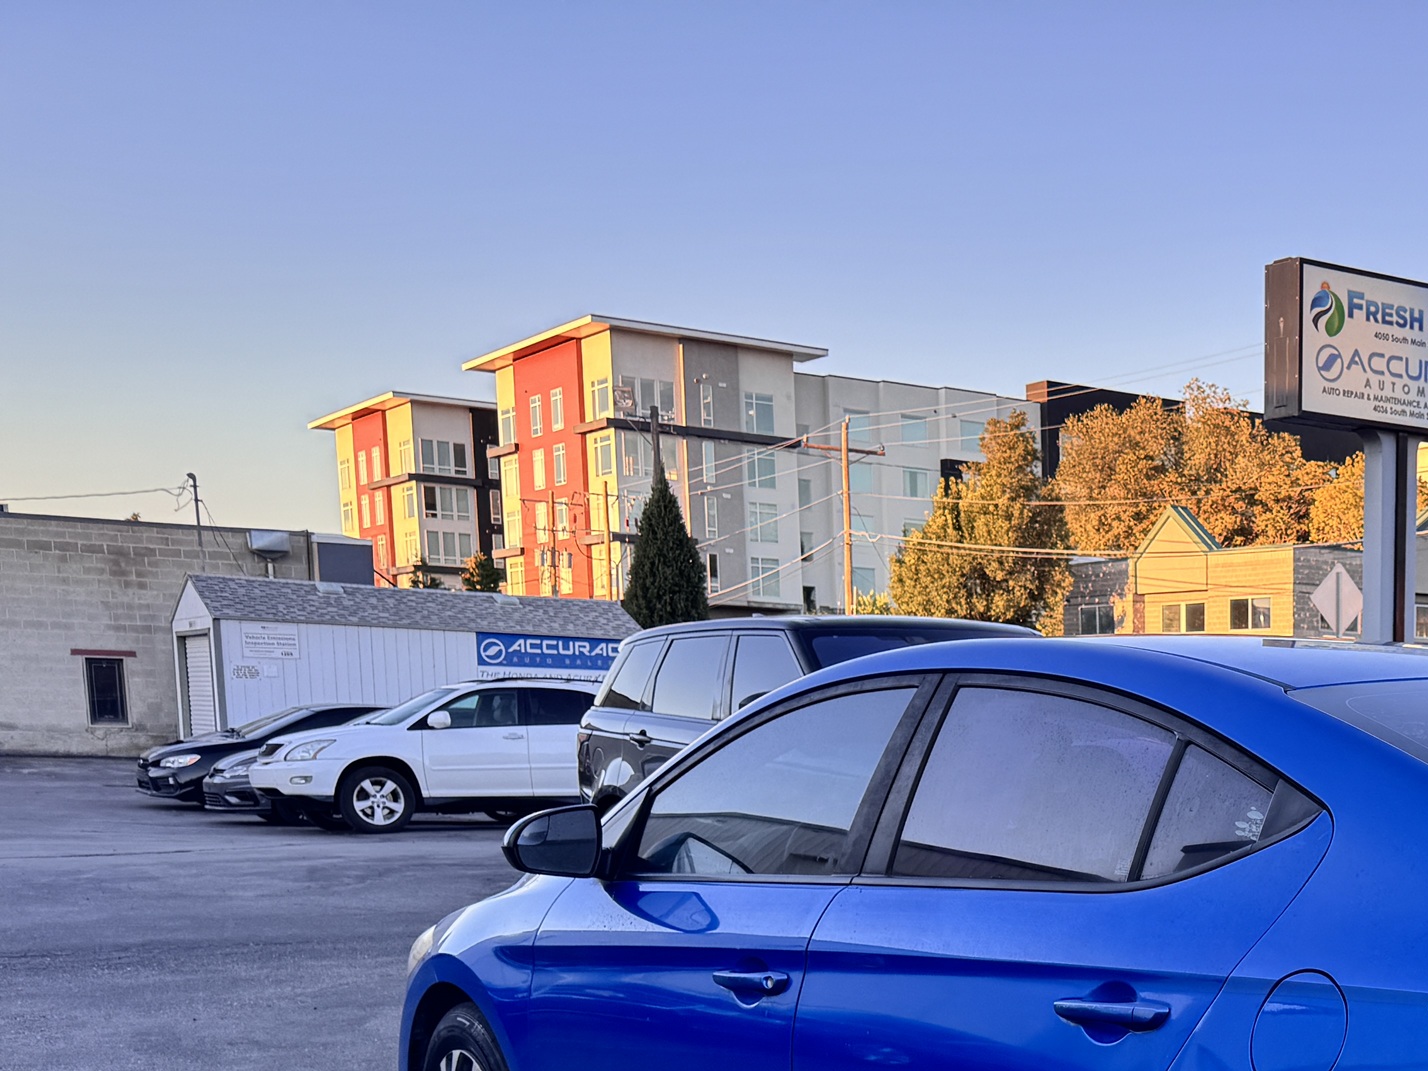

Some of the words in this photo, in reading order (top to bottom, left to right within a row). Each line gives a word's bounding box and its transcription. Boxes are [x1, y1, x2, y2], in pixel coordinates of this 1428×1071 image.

[1347, 289, 1424, 332] FRESH
[1374, 331, 1390, 341] 4050
[1391, 334, 1409, 344] South
[1410, 339, 1427, 348] Main
[1322, 386, 1340, 396] AUTO
[1342, 389, 1365, 400] REPAIR
[1366, 393, 1371, 401] &
[1389, 406, 1408, 417] South
[1409, 409, 1425, 419] Main
[512, 656, 552, 664] AUTO
